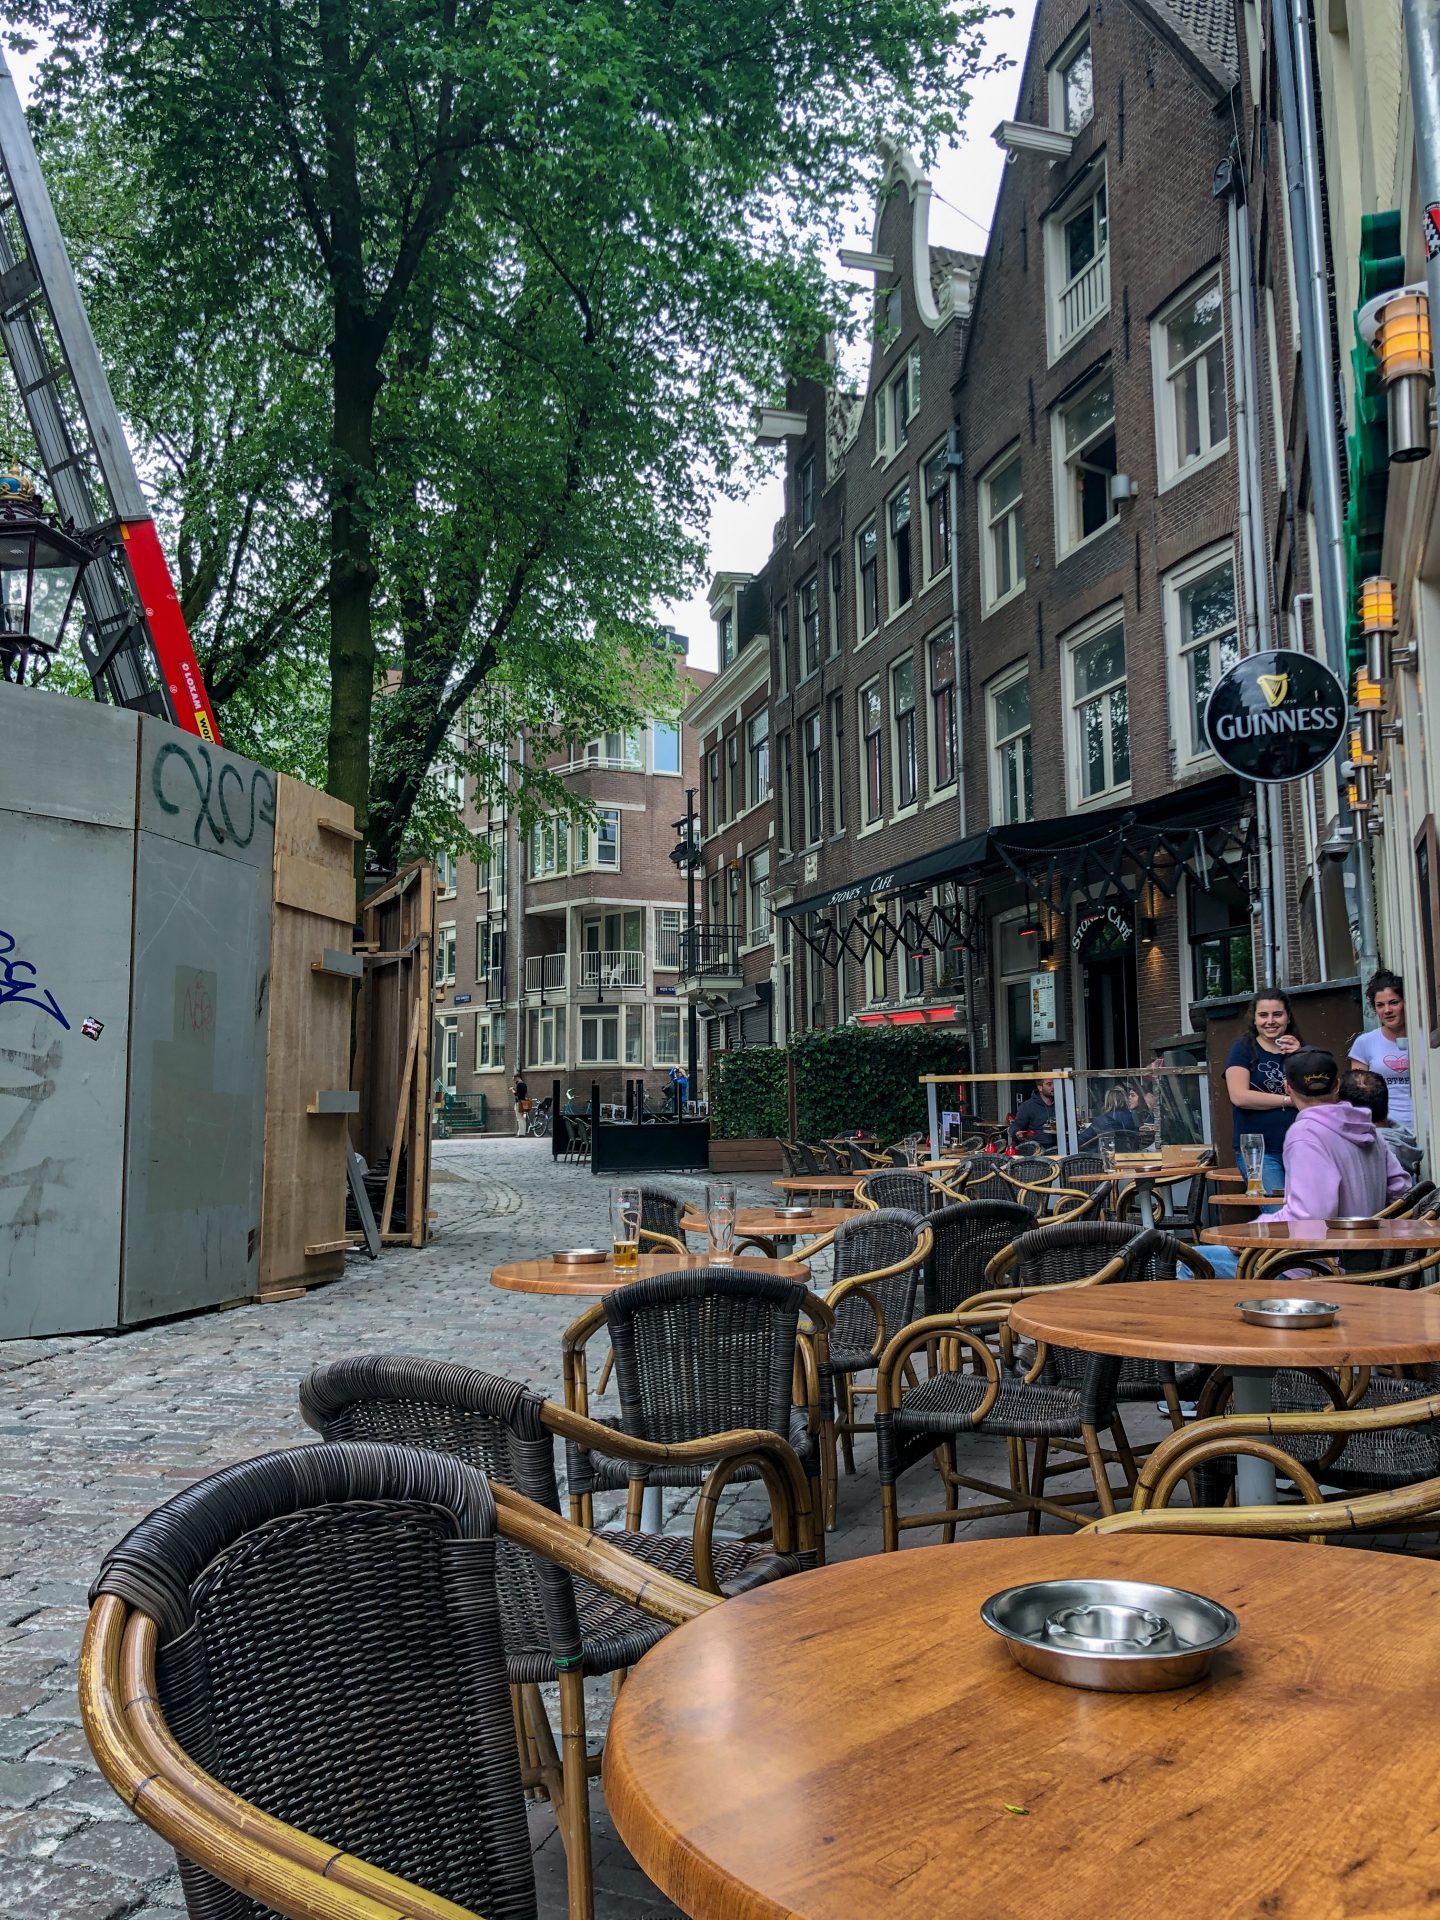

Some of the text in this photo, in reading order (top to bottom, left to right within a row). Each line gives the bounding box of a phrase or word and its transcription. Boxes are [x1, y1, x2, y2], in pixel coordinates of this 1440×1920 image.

[183, 672, 214, 744] LOXAM wor
[1216, 707, 1338, 741] GUINNESS
[1072, 906, 1105, 950] STON
